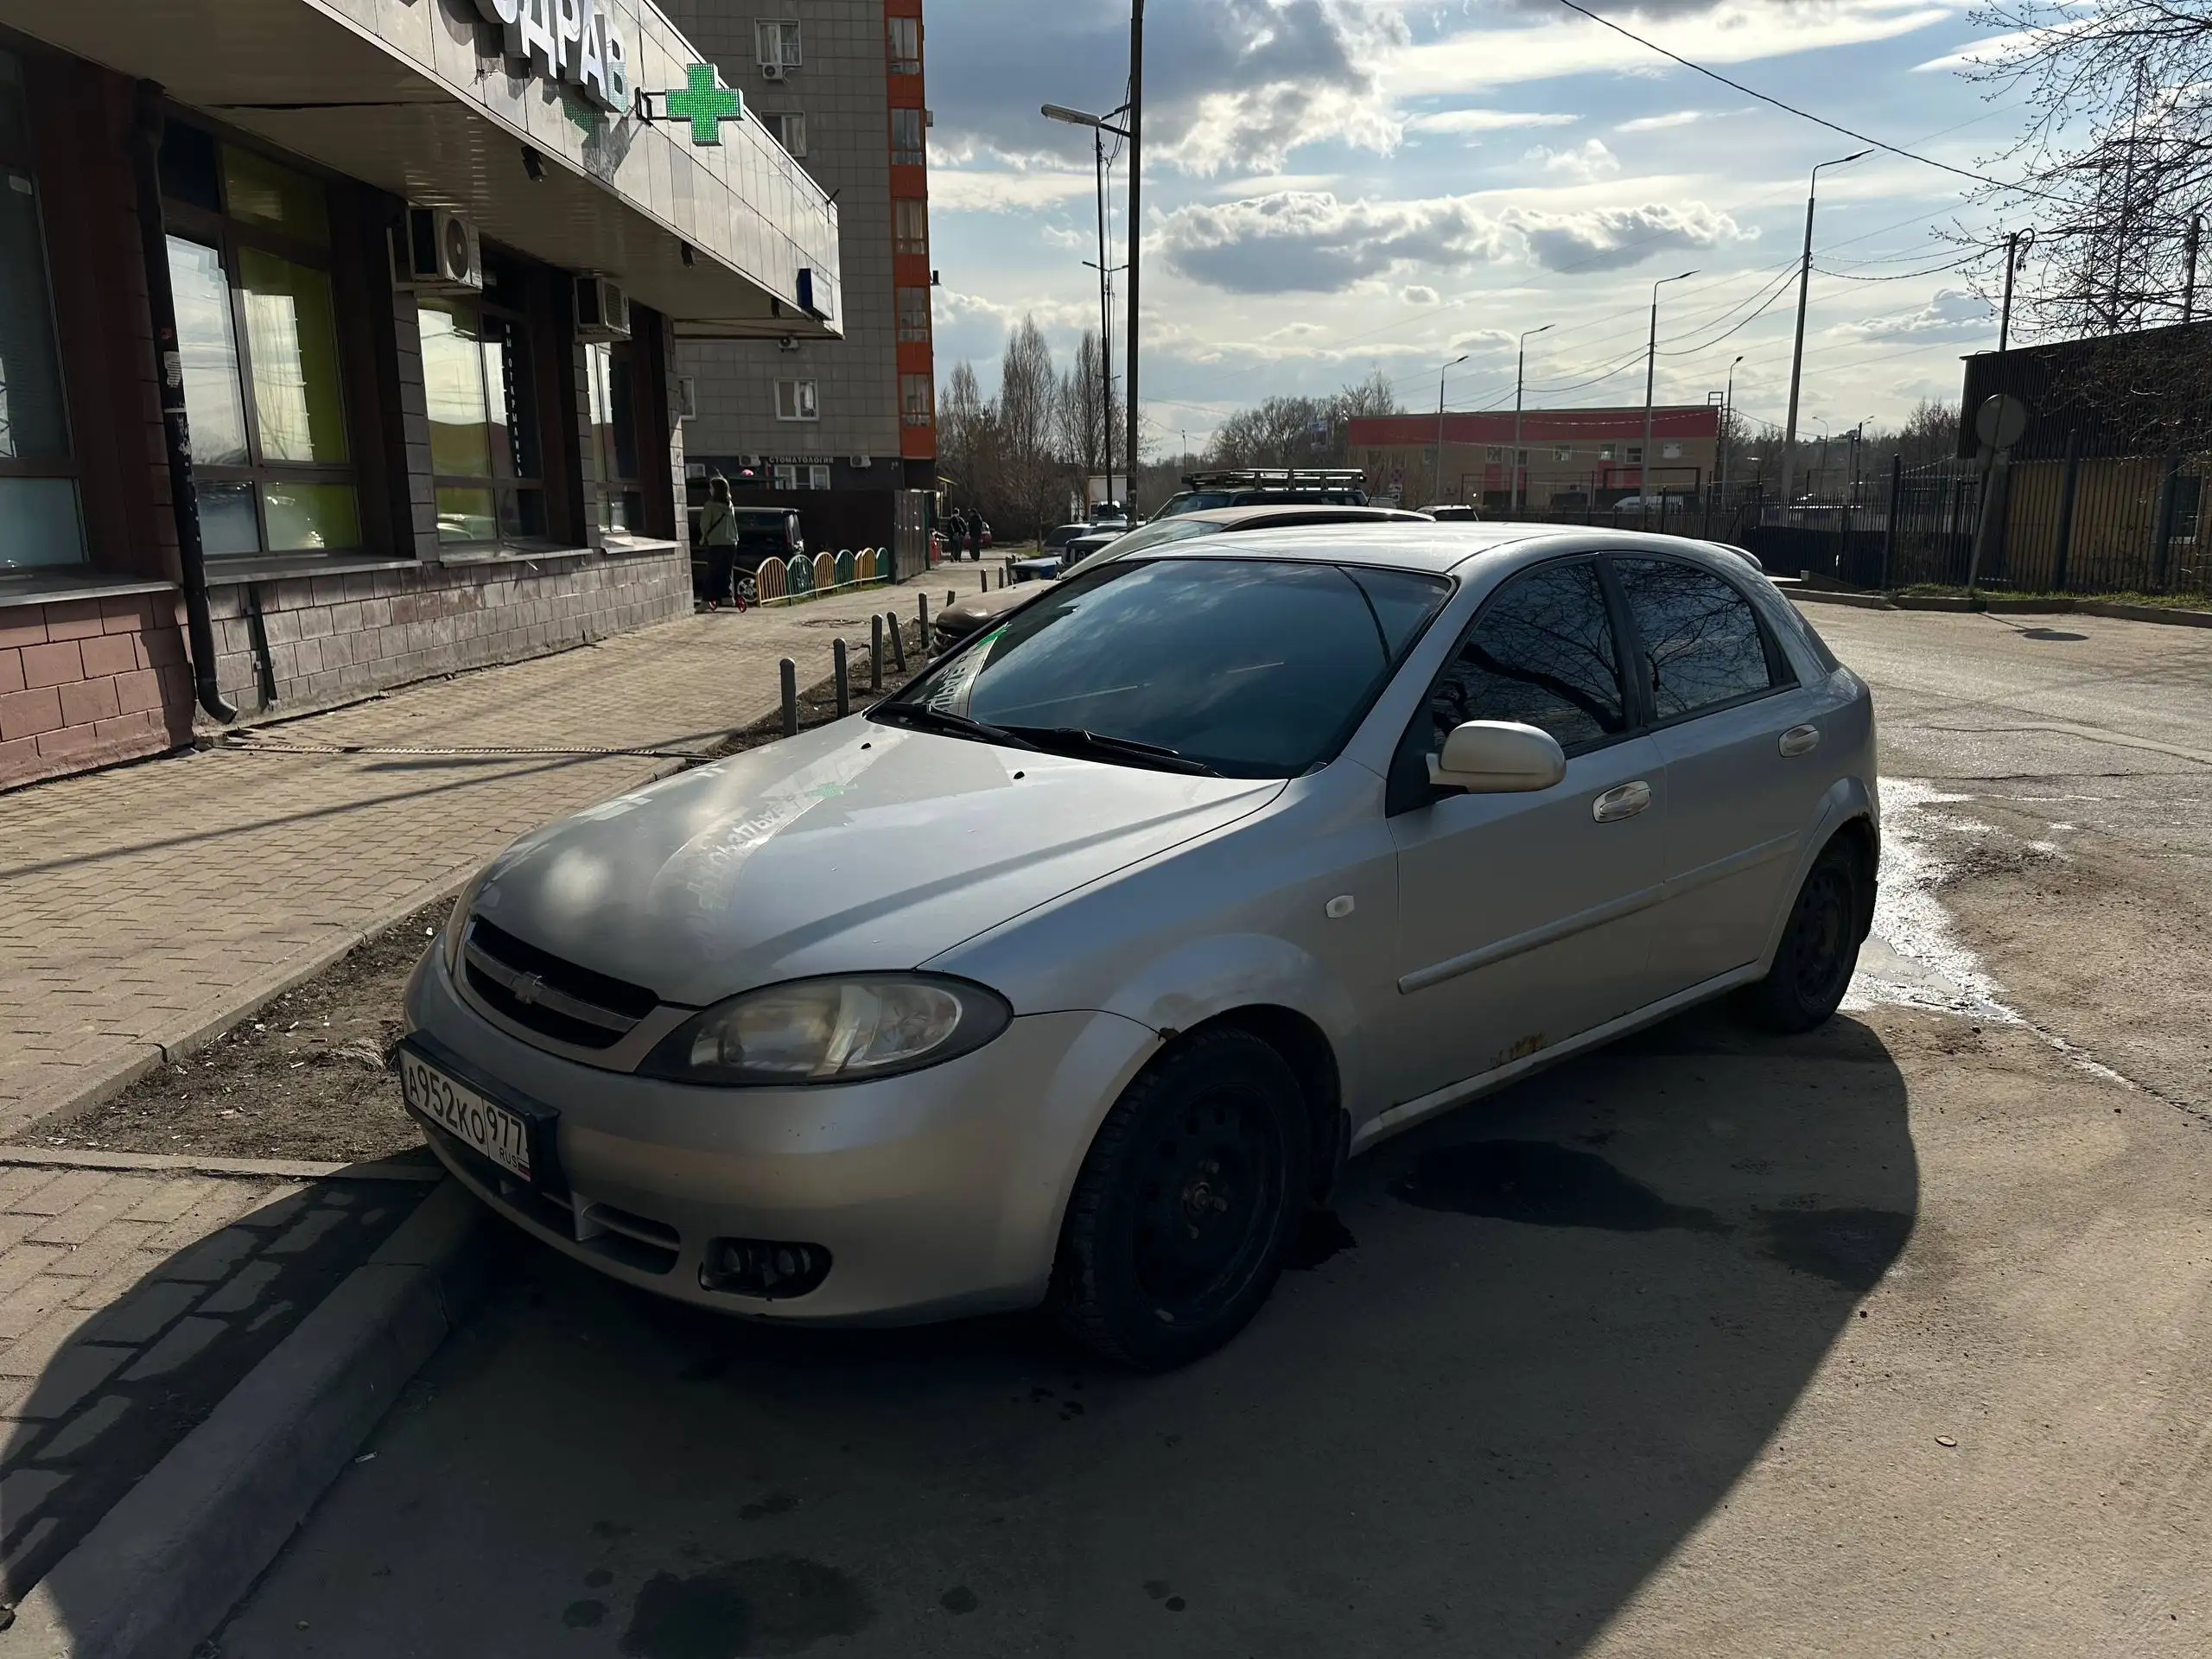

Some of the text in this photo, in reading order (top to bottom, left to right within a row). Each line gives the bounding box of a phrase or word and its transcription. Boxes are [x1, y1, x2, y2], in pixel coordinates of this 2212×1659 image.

[493, 0, 628, 112] ДРАВ
[769, 455, 834, 464] СТОМАТОЛОГИЯ
[499, 1147, 518, 1167] RUS
